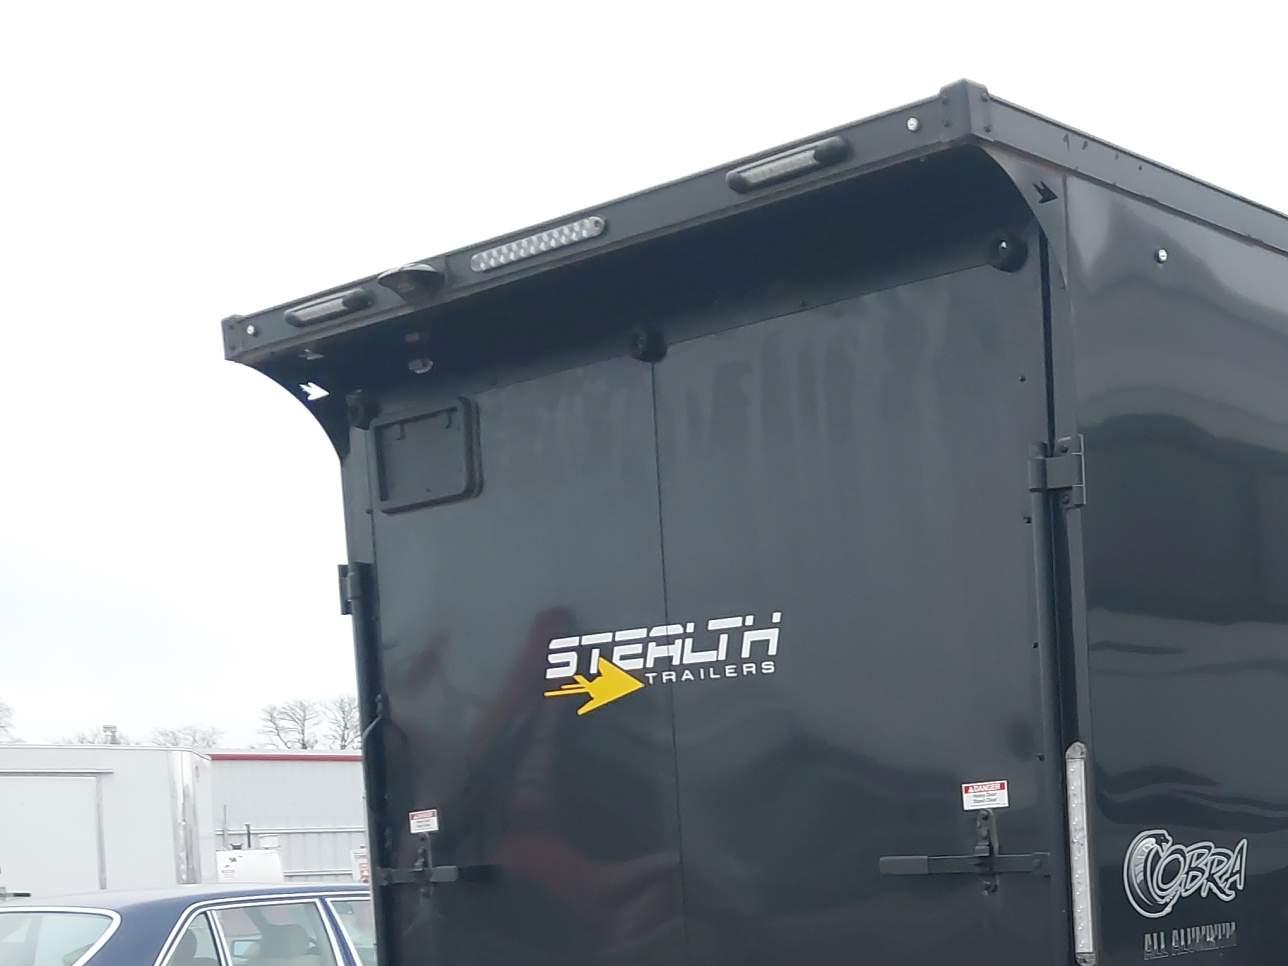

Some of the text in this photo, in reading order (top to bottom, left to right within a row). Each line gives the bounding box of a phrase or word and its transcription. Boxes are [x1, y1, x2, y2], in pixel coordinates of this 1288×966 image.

[545, 611, 782, 679] STEALTH
[645, 661, 775, 684] TRAILERS
[1123, 829, 1248, 918] COBRA
